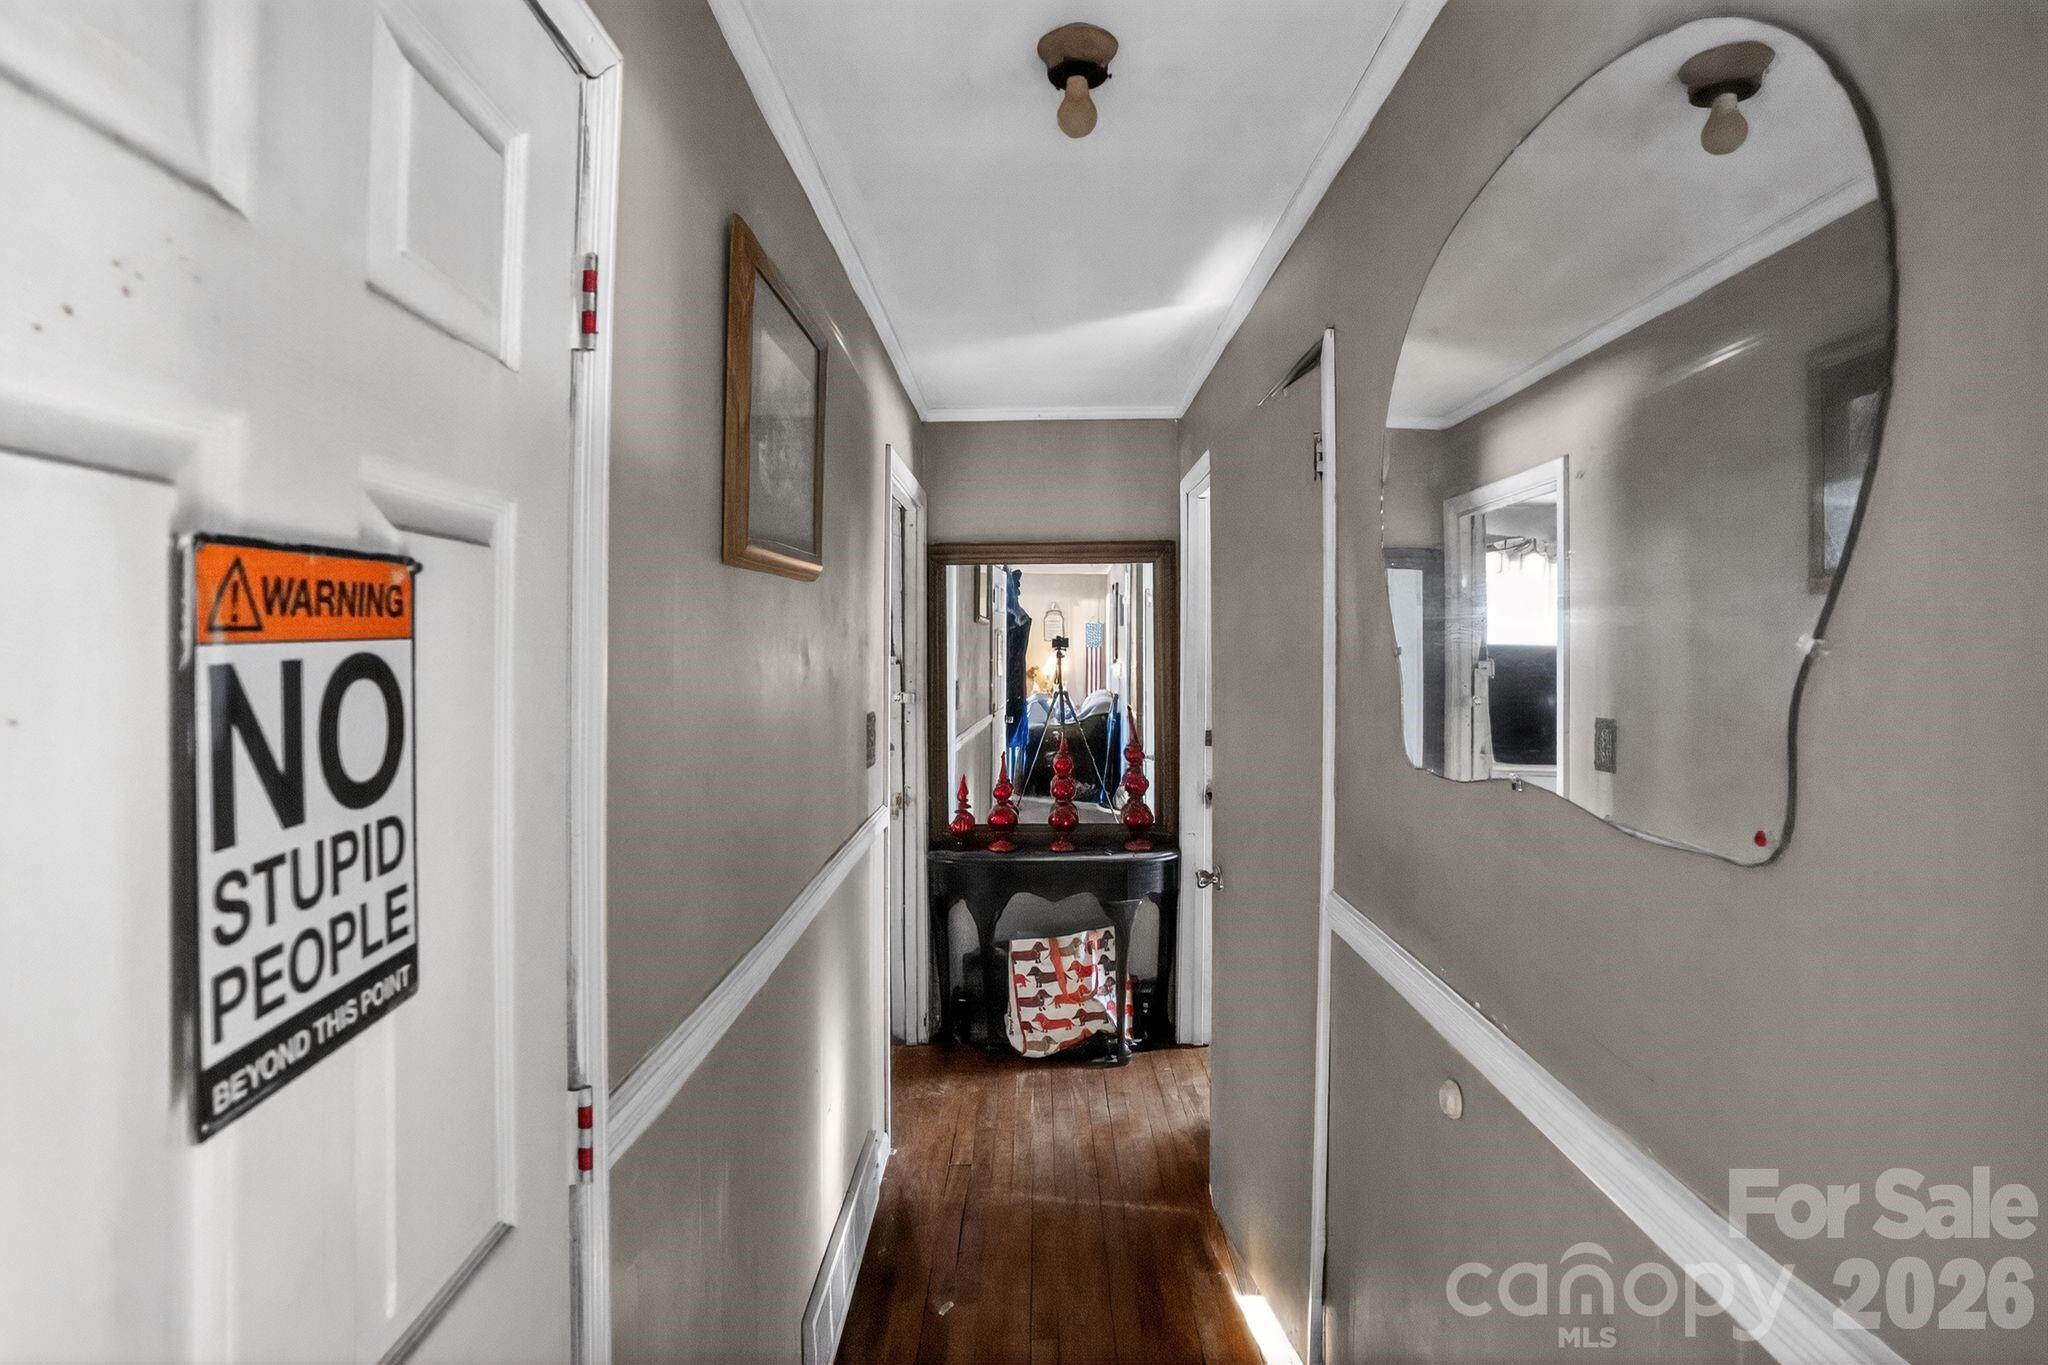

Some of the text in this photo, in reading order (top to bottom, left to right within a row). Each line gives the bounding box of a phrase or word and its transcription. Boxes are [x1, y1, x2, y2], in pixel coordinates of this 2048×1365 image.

[260, 576, 404, 618] WARNING
[208, 652, 405, 852] NO
[213, 815, 405, 947] STUPID
[211, 883, 409, 1045] PEOPLE
[212, 964, 411, 1115] BEYOND THIS POINT
